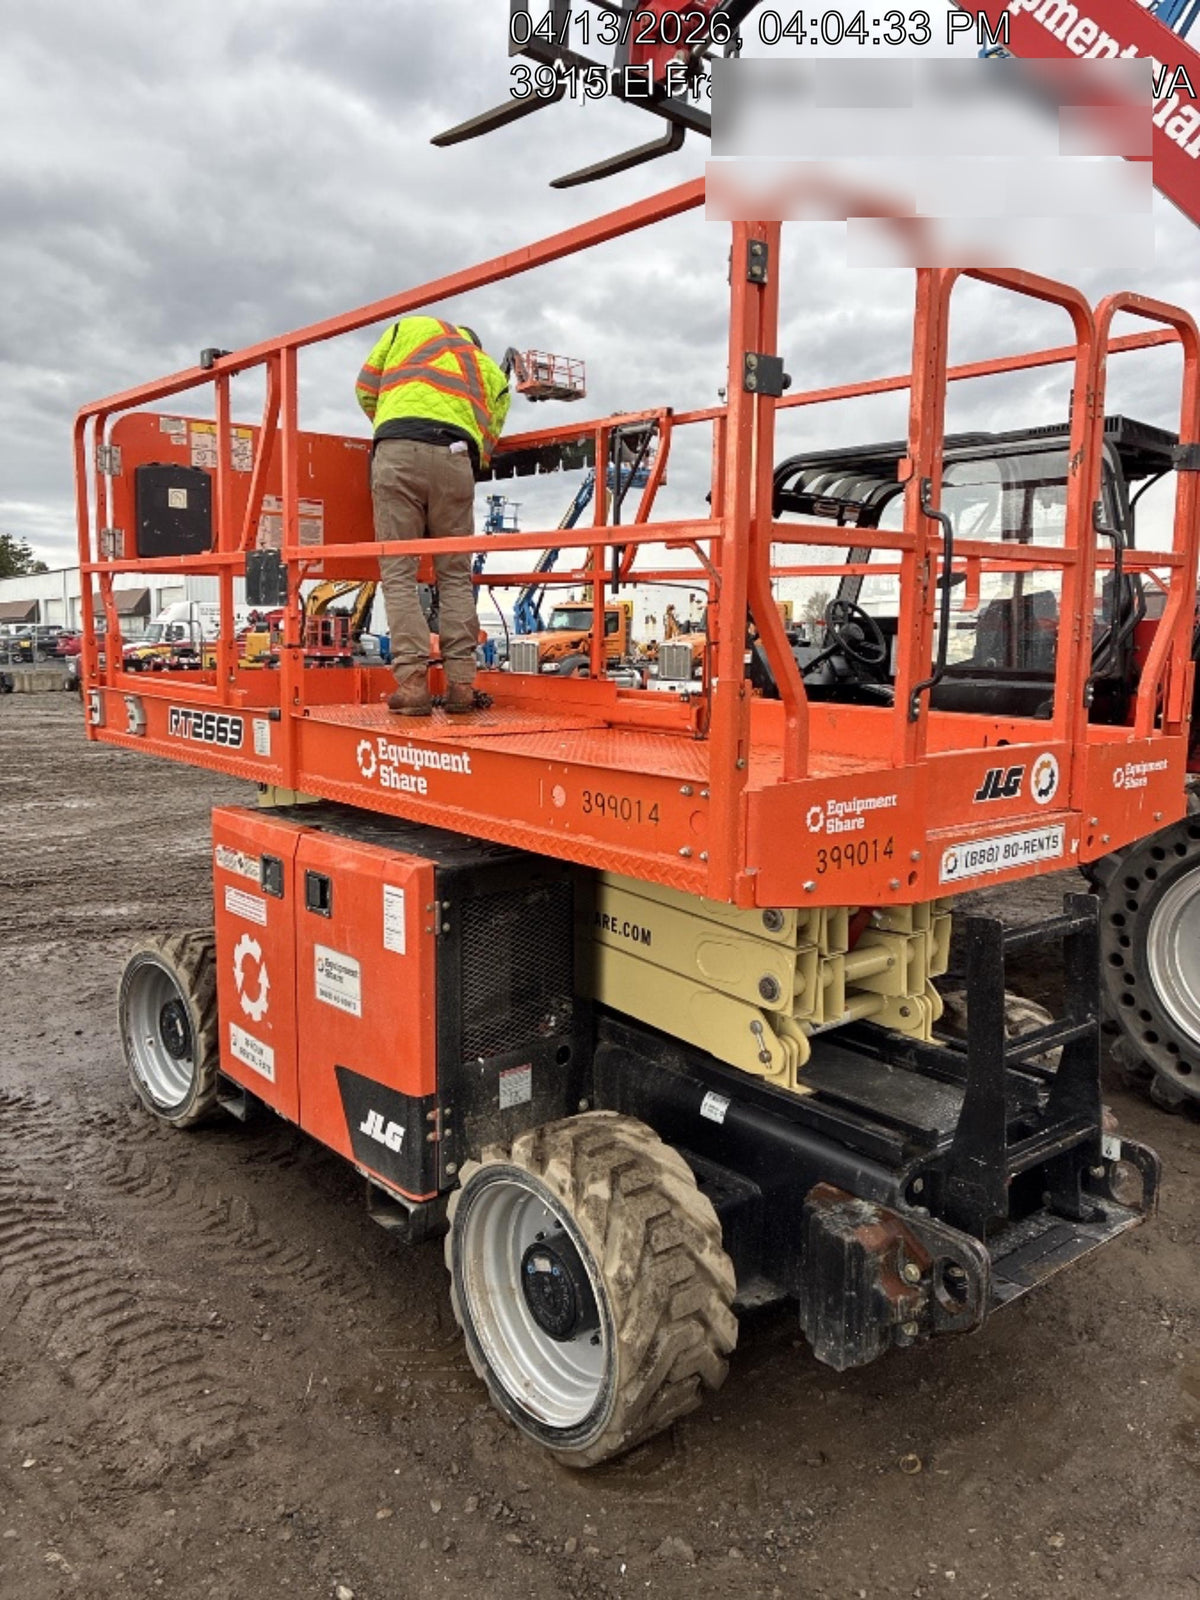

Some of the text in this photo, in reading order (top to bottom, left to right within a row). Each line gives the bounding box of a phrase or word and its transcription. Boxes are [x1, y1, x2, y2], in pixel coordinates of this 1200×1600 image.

[168, 706, 244, 749] RT2669
[376, 737, 472, 774] Equipment
[1124, 758, 1168, 778] Equipment
[379, 764, 428, 795] Share
[973, 765, 1026, 803] JLG
[1124, 776, 1148, 789] Share
[582, 790, 661, 825] 399014
[826, 794, 898, 817] Equipment
[826, 817, 865, 834] Share
[816, 836, 894, 874] 399014
[964, 834, 1059, 868] (888) 80-RENTS
[360, 1109, 406, 1152] JLG
